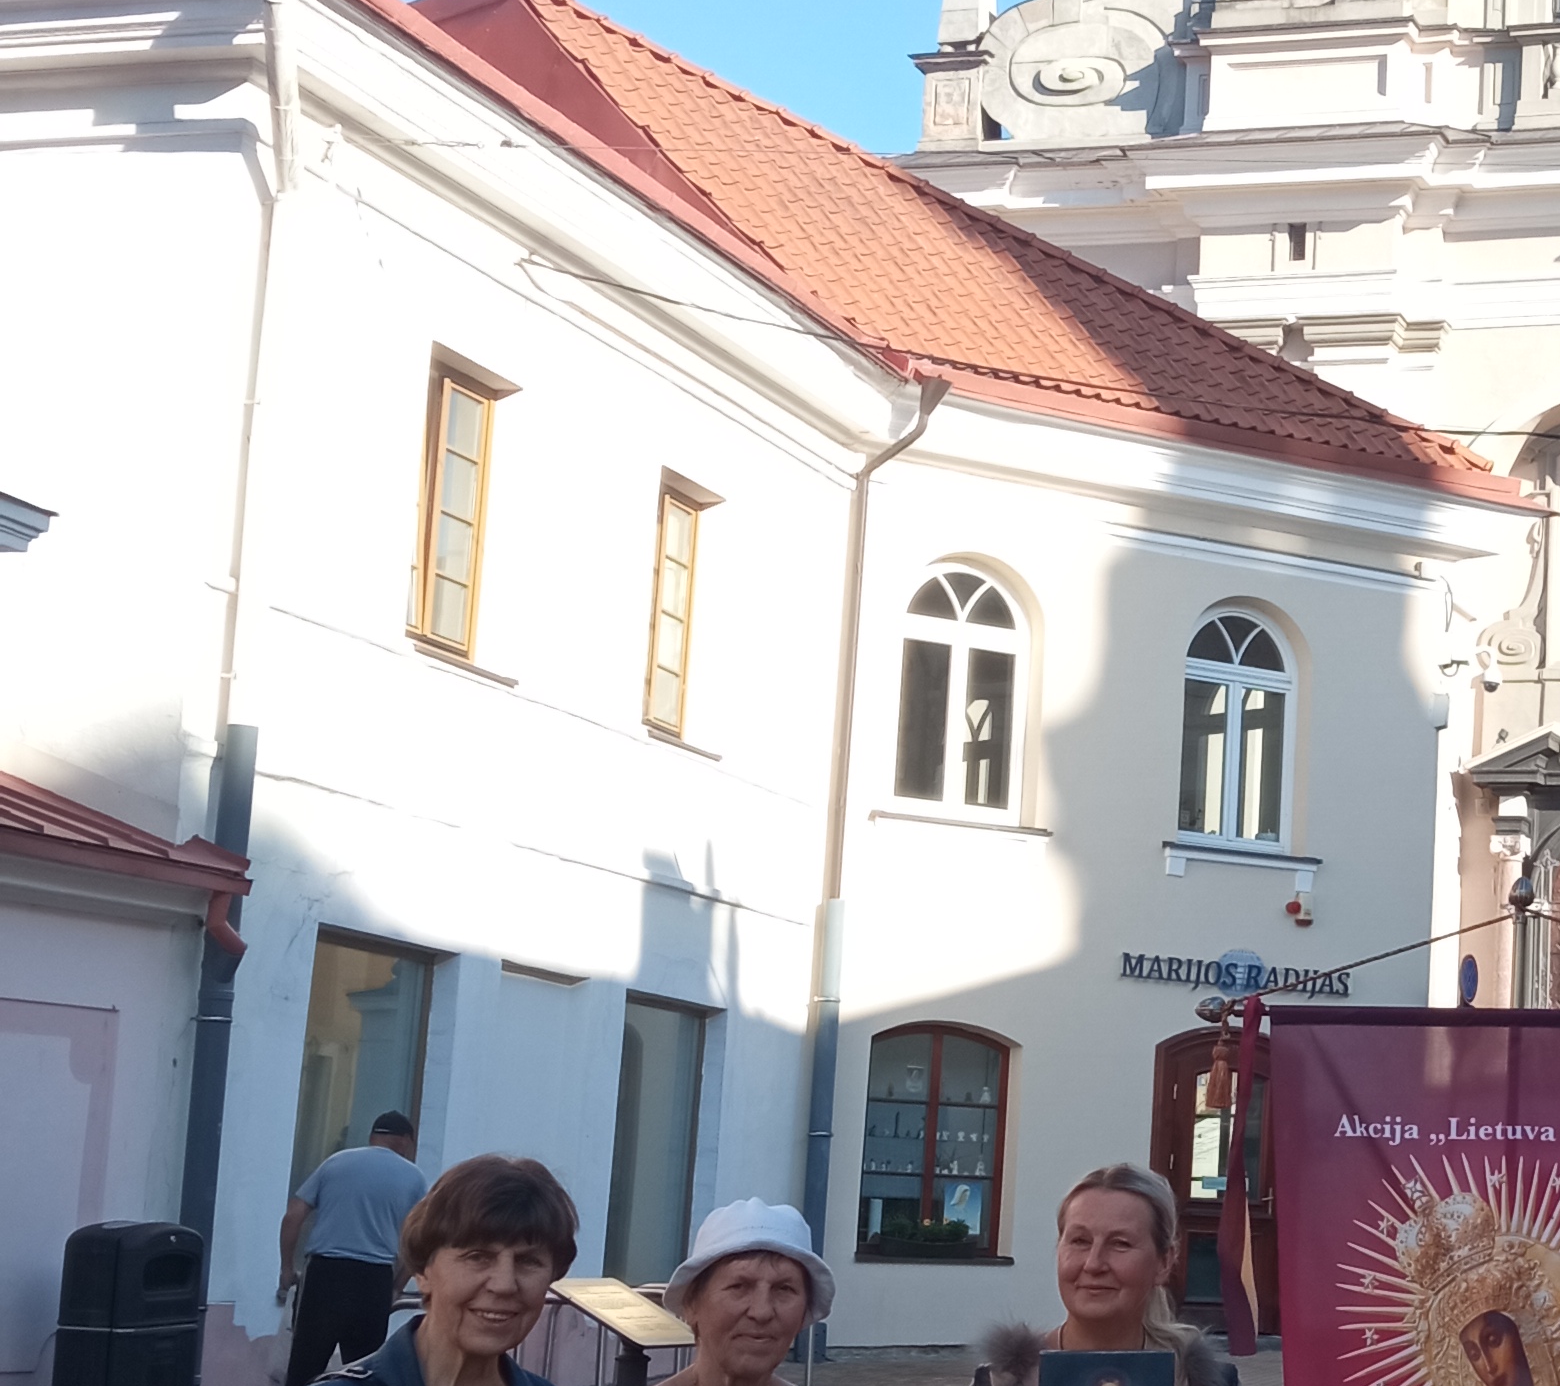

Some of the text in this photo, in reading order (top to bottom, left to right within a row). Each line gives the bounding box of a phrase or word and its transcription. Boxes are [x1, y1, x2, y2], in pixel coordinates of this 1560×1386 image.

[1121, 952, 1351, 999] MARIJOS RADIJAS
[1333, 1114, 1419, 1146] Akcija
